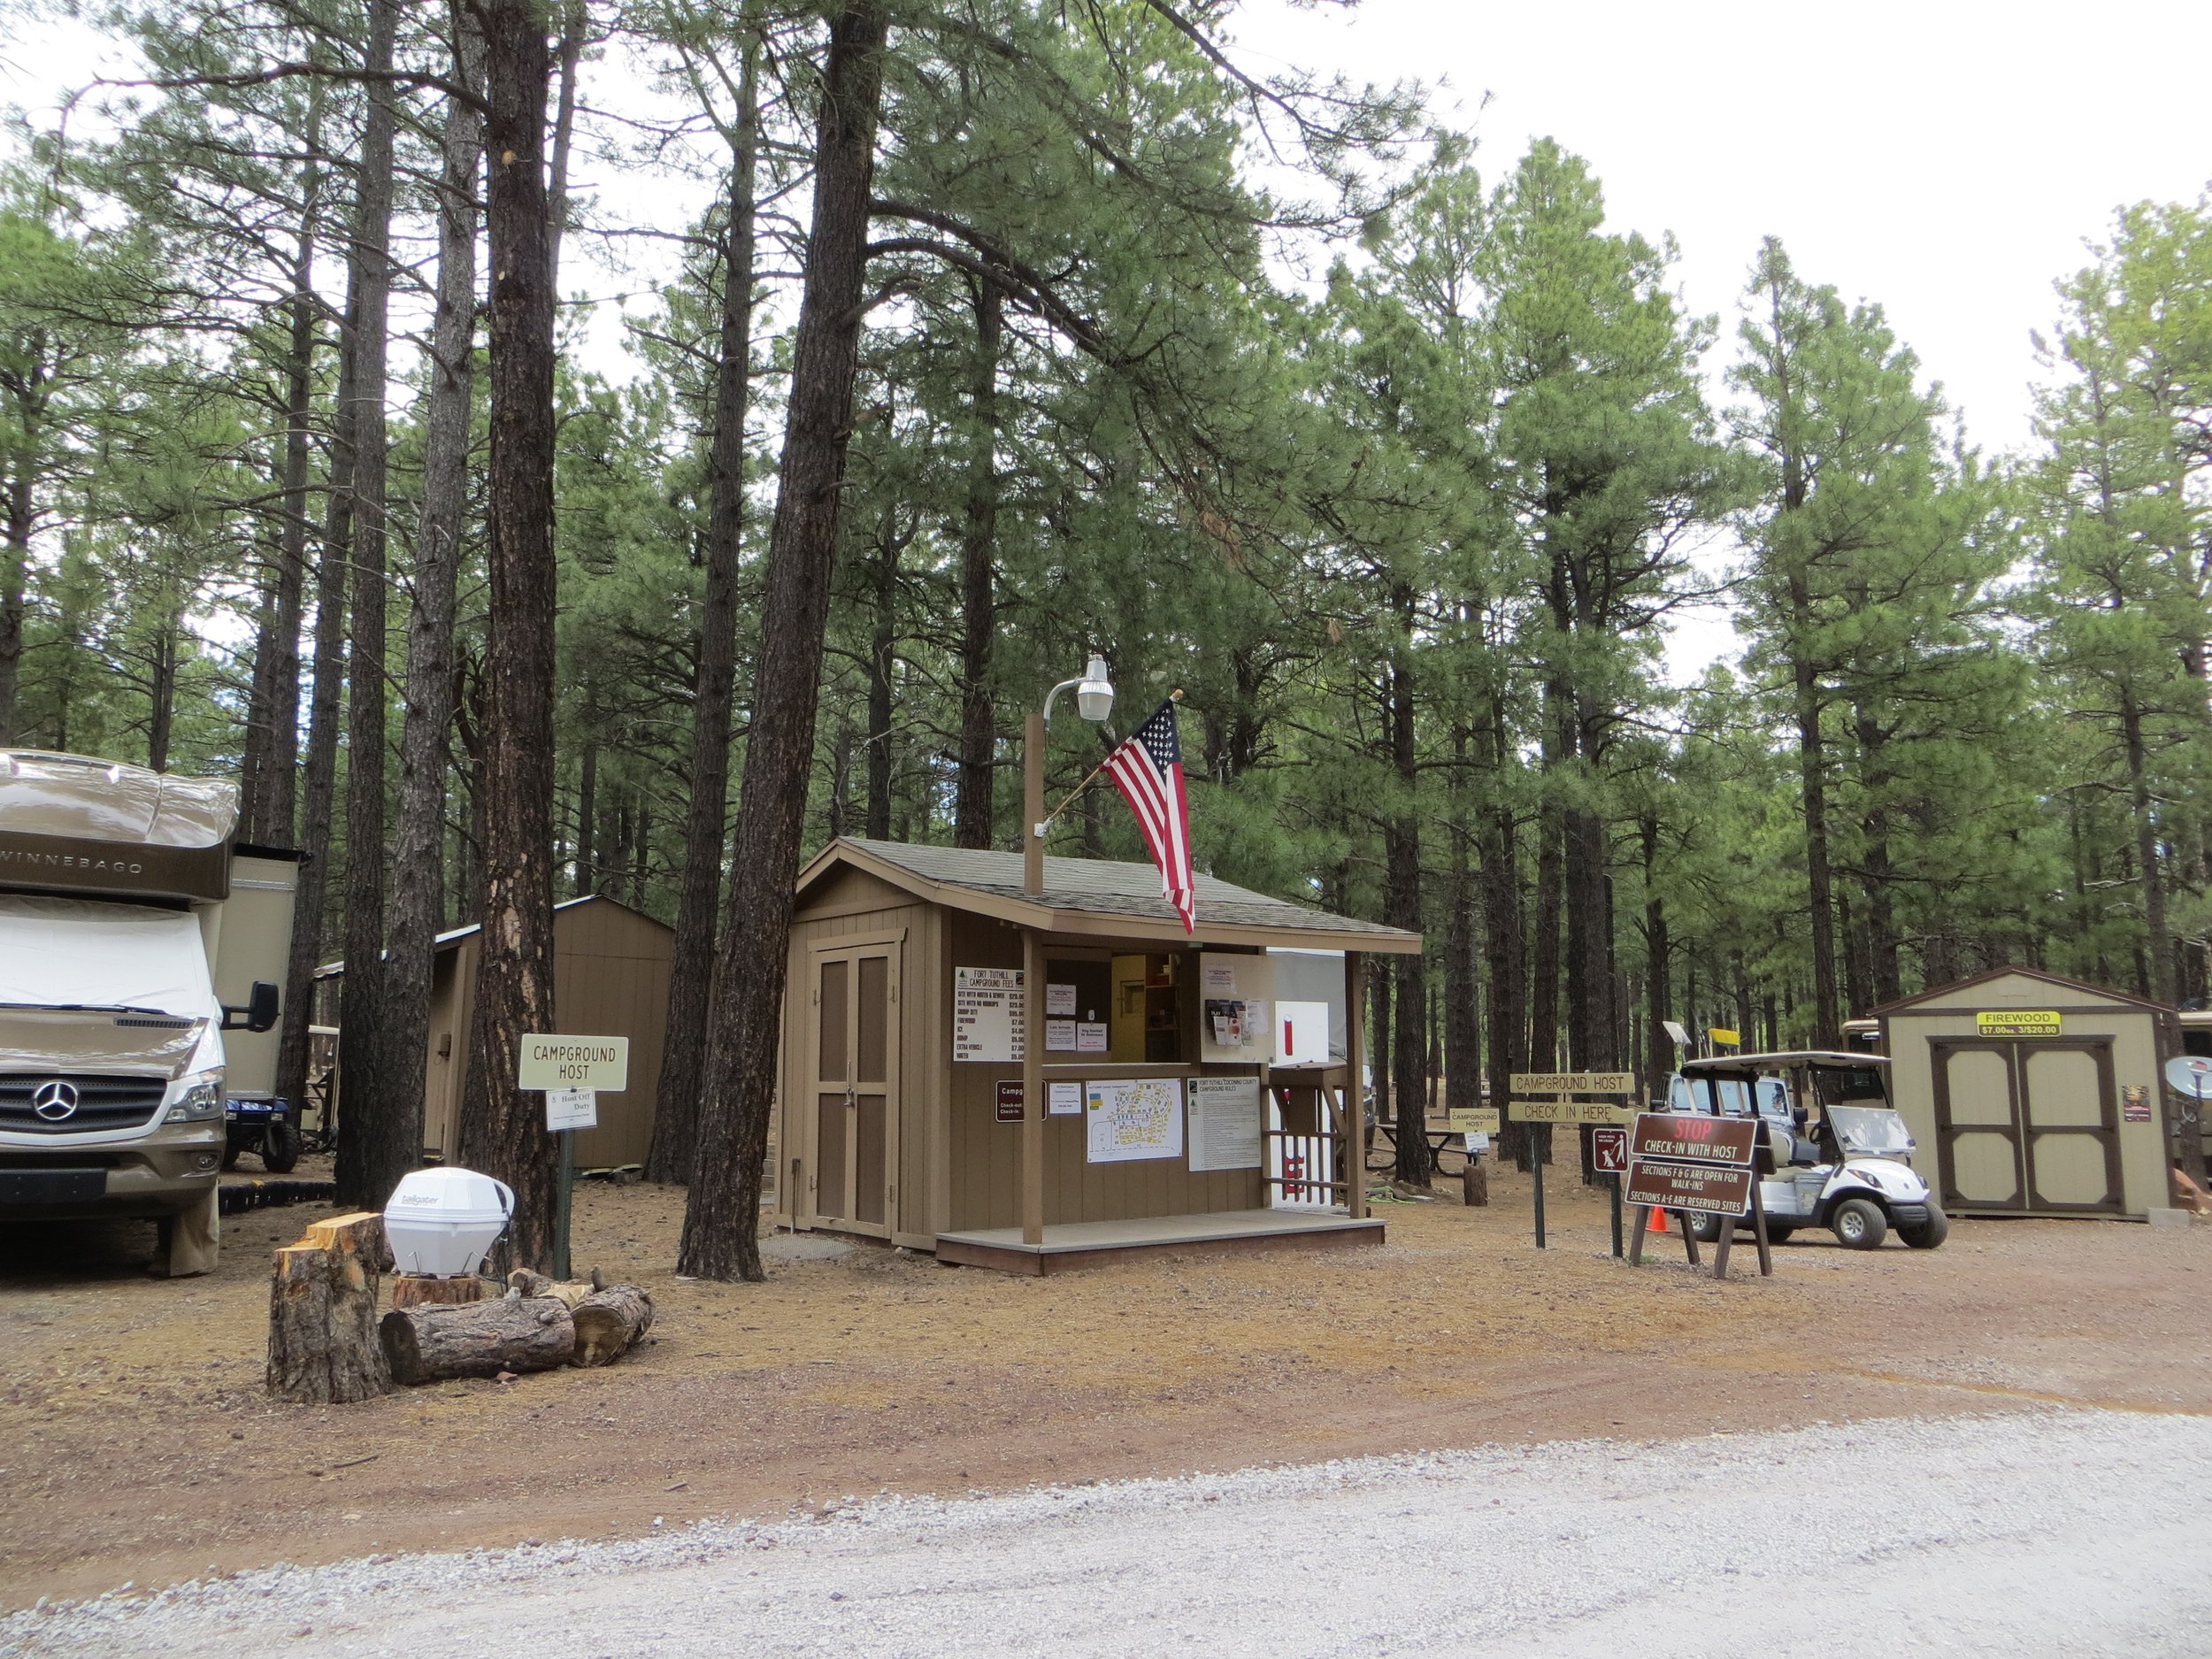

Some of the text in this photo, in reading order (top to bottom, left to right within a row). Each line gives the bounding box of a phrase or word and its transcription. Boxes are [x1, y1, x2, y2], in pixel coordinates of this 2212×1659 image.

[974, 970, 1009, 979] FORT TUTHILL
[970, 979, 1000, 987] CAMPGROUND
[1985, 1013, 2051, 1023] FIREWOOD
[534, 1045, 616, 1062] CAMPGROUND
[559, 1064, 589, 1079] HOST
[1517, 1076, 1624, 1090] CAMPGROUND HOST
[1002, 1087, 1023, 1096] Campg
[1525, 1105, 1612, 1120] CHECK IN HERE
[1674, 1118, 1713, 1141] STOP
[1645, 1140, 1738, 1159] CHECK-IN WITH HOST
[1641, 1165, 1672, 1178] SECTIONS
[1685, 1170, 1689, 1179] G
[1690, 1170, 1703, 1179] ARE
[1704, 1171, 1723, 1182] OPEN
[1724, 1173, 1739, 1183] FOR
[1671, 1179, 1704, 1191] WALK-INS
[402, 1194, 440, 1205] tailgater
[1631, 1191, 1741, 1212] SECTIONS A-E ARE RESERVED SITES
